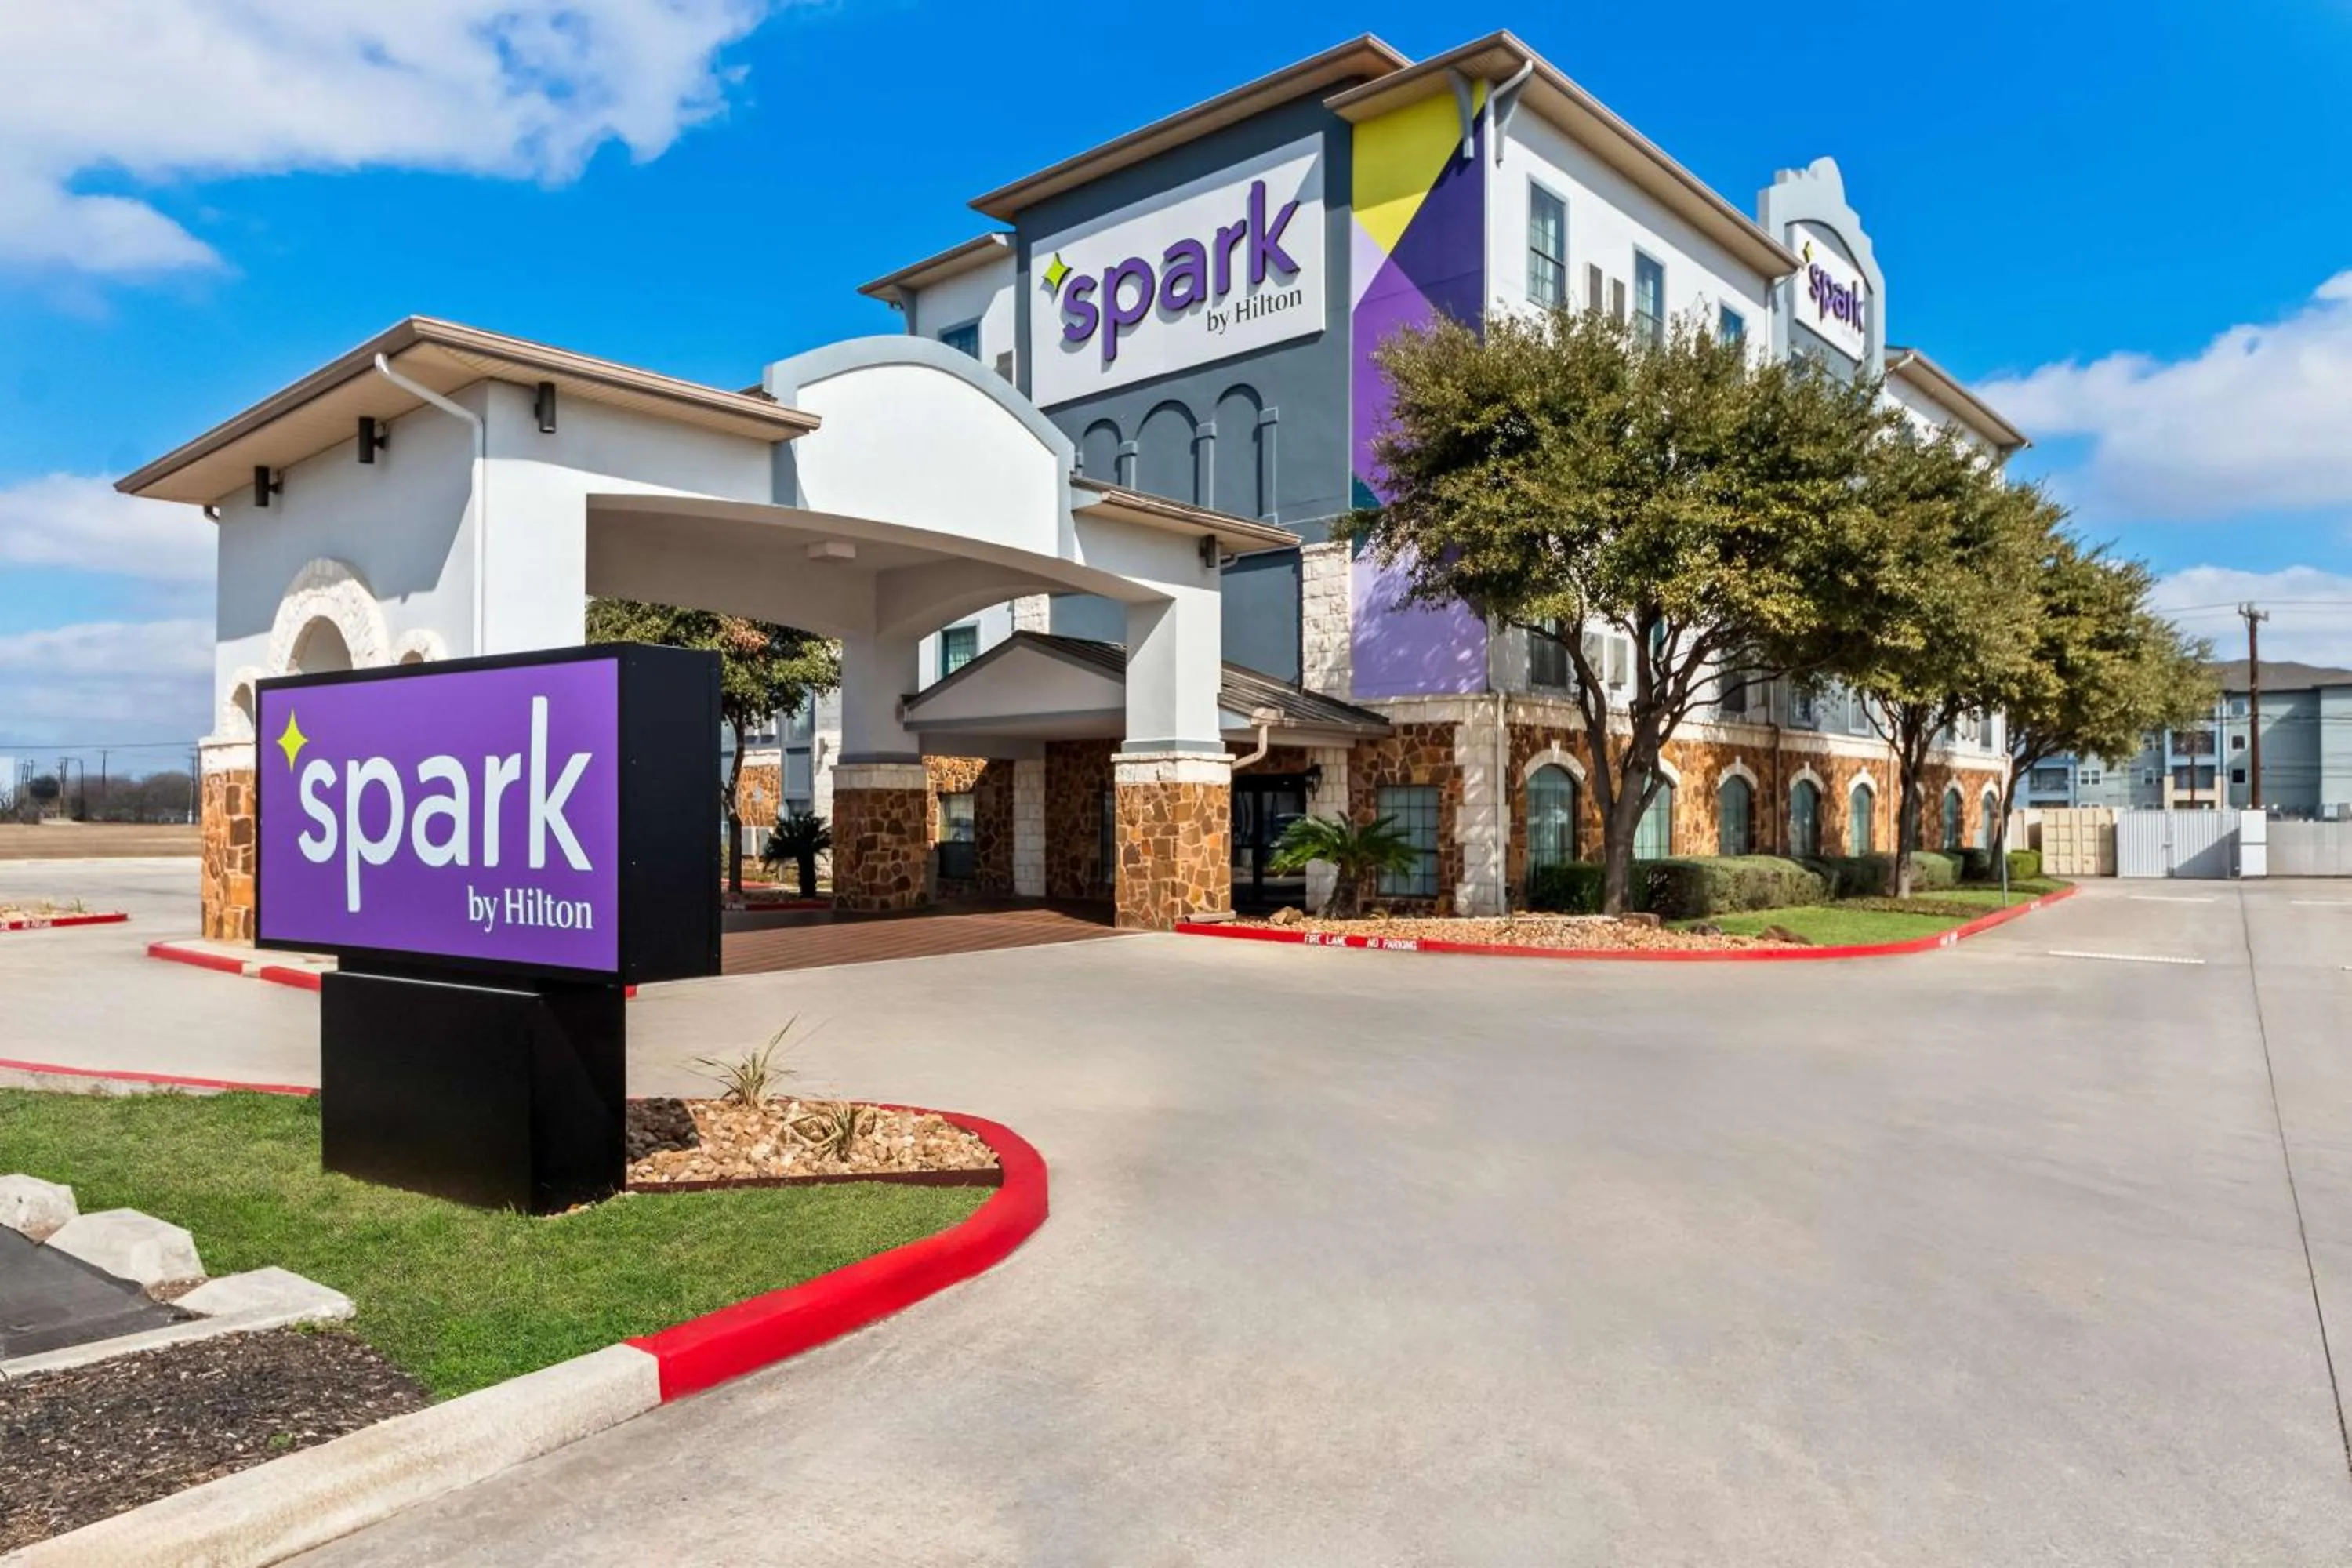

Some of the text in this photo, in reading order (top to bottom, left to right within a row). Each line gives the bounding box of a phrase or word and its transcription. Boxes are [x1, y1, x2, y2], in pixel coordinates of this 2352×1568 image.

[1063, 180, 1301, 362] spark
[1809, 263, 1864, 333] spark
[1207, 289, 1302, 335] by Hilton
[298, 695, 593, 913] spark
[468, 884, 593, 933] by Hilton
[1304, 934, 1417, 951] FIRE LANE NO PARKING
